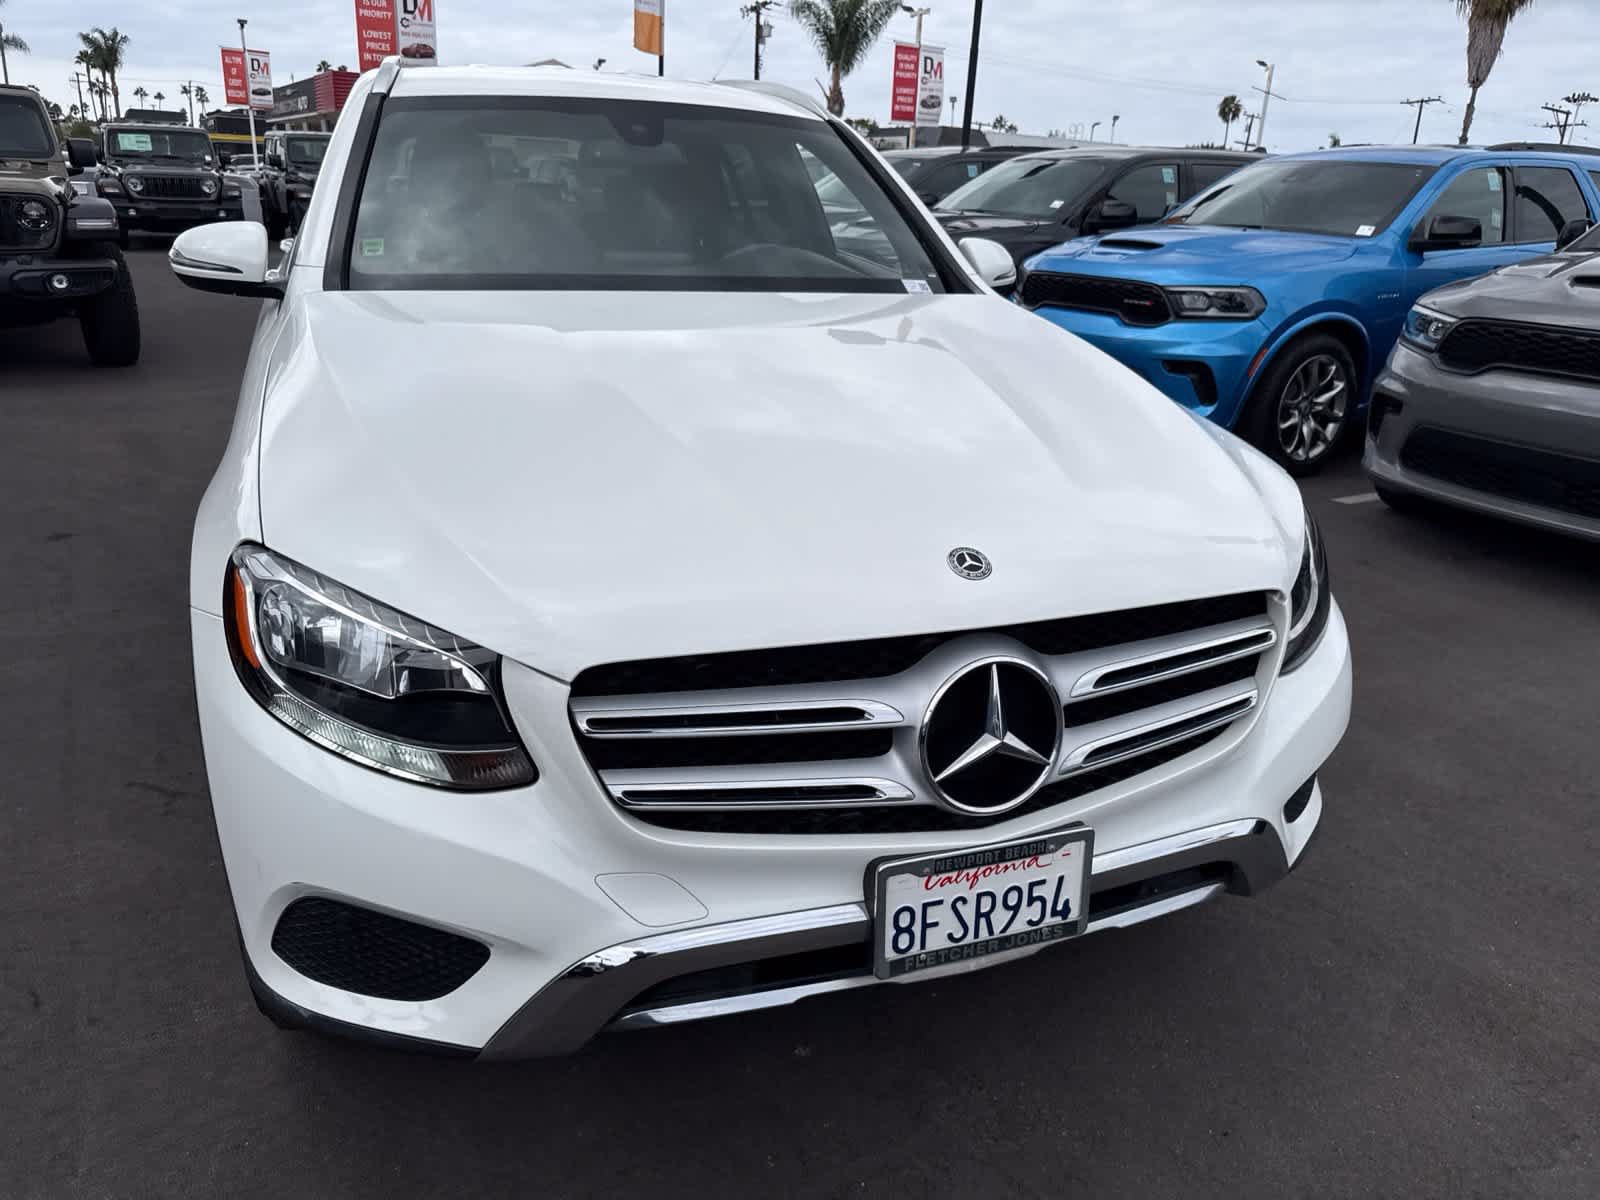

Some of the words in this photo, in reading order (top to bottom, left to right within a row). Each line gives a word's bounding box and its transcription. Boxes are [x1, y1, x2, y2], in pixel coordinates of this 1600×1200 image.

[359, 8, 392, 19] PRIORITY
[362, 29, 392, 40] LOWEST
[365, 41, 391, 51] PRICES
[923, 854, 1051, 891] California
[936, 849, 1000, 874] NEWPORT
[1005, 841, 1047, 860] BEACH
[891, 874, 1072, 955] 8FSR954
[904, 939, 1000, 973] FLETCHER
[1005, 925, 1065, 949] JONES
